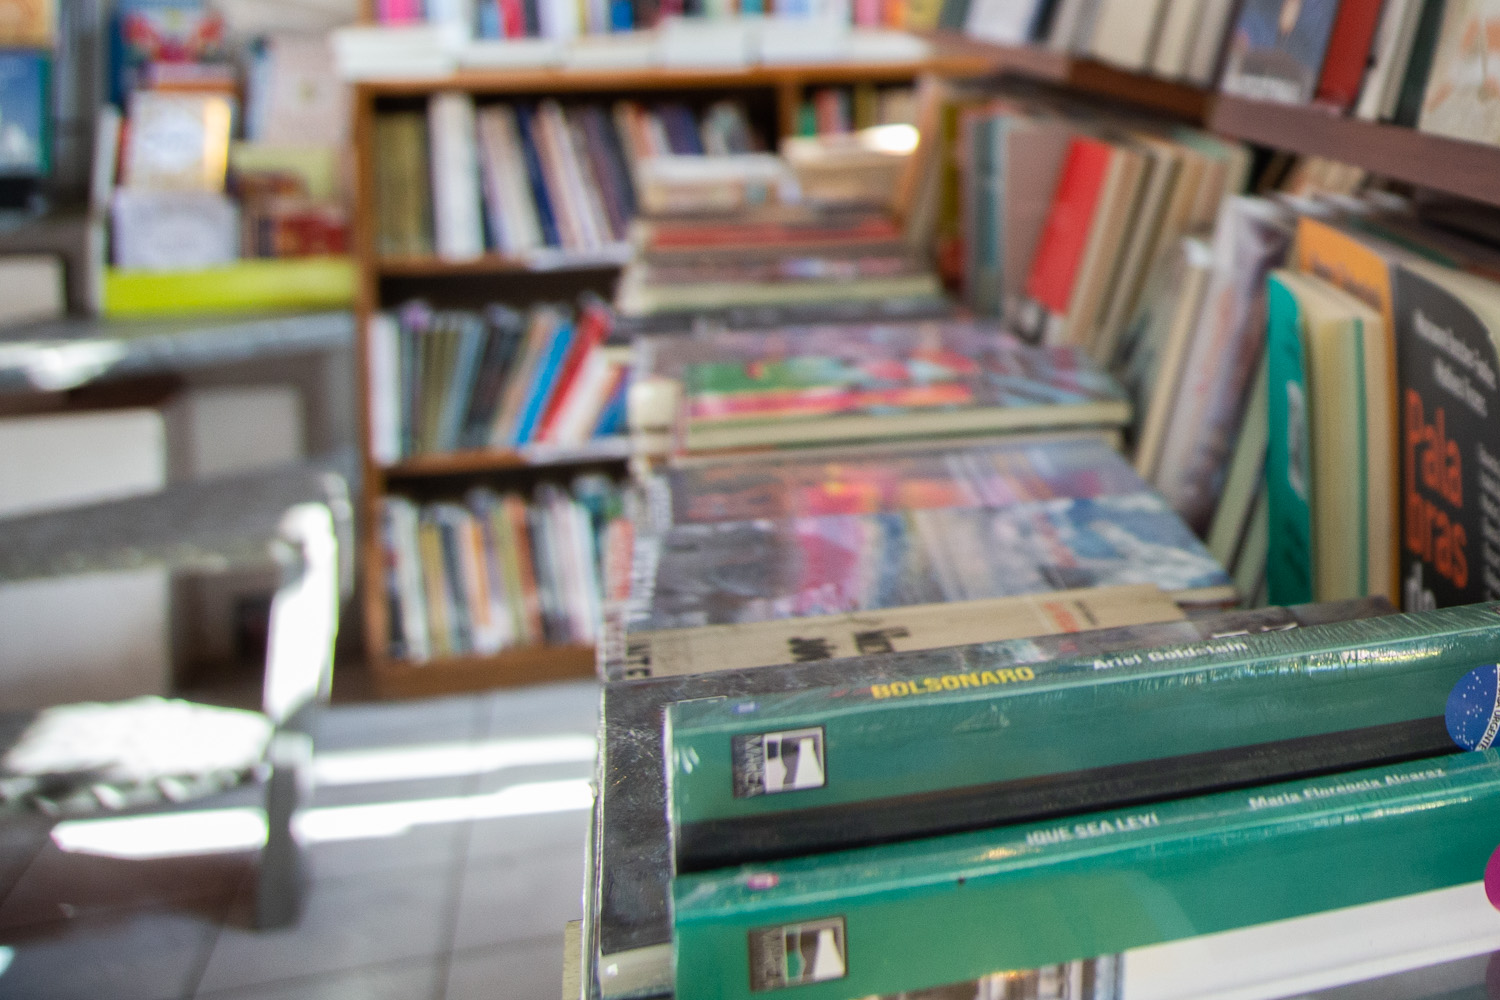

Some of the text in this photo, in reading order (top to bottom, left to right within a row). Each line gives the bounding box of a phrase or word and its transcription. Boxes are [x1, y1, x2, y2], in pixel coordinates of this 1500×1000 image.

[872, 665, 1034, 699] BOLSONARO
[1094, 653, 1142, 671] Ariel
[1074, 818, 1115, 840] SEA
